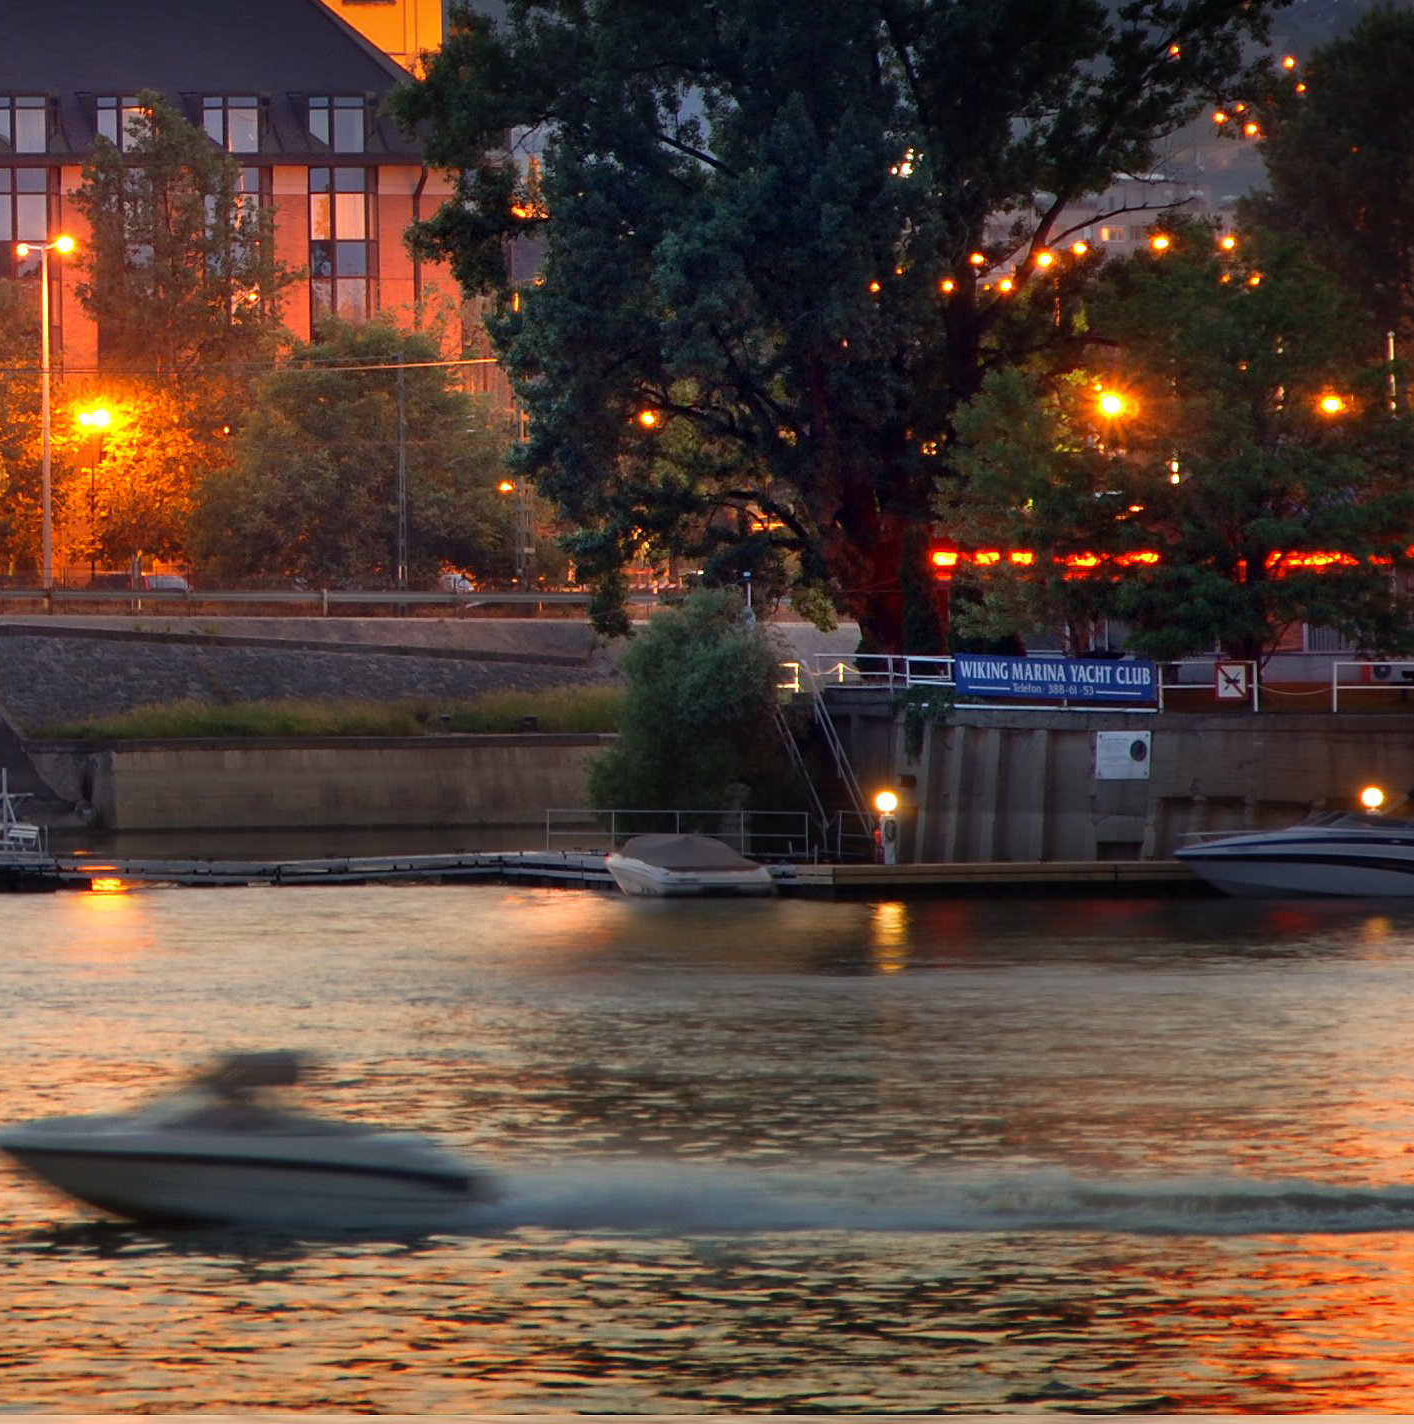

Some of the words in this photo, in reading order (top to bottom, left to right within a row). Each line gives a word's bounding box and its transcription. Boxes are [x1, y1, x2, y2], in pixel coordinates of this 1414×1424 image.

[960, 660, 1009, 680] WIKING
[1012, 663, 1066, 683] MARINA
[1070, 664, 1112, 685] YACHT
[1115, 666, 1151, 685] CLUB
